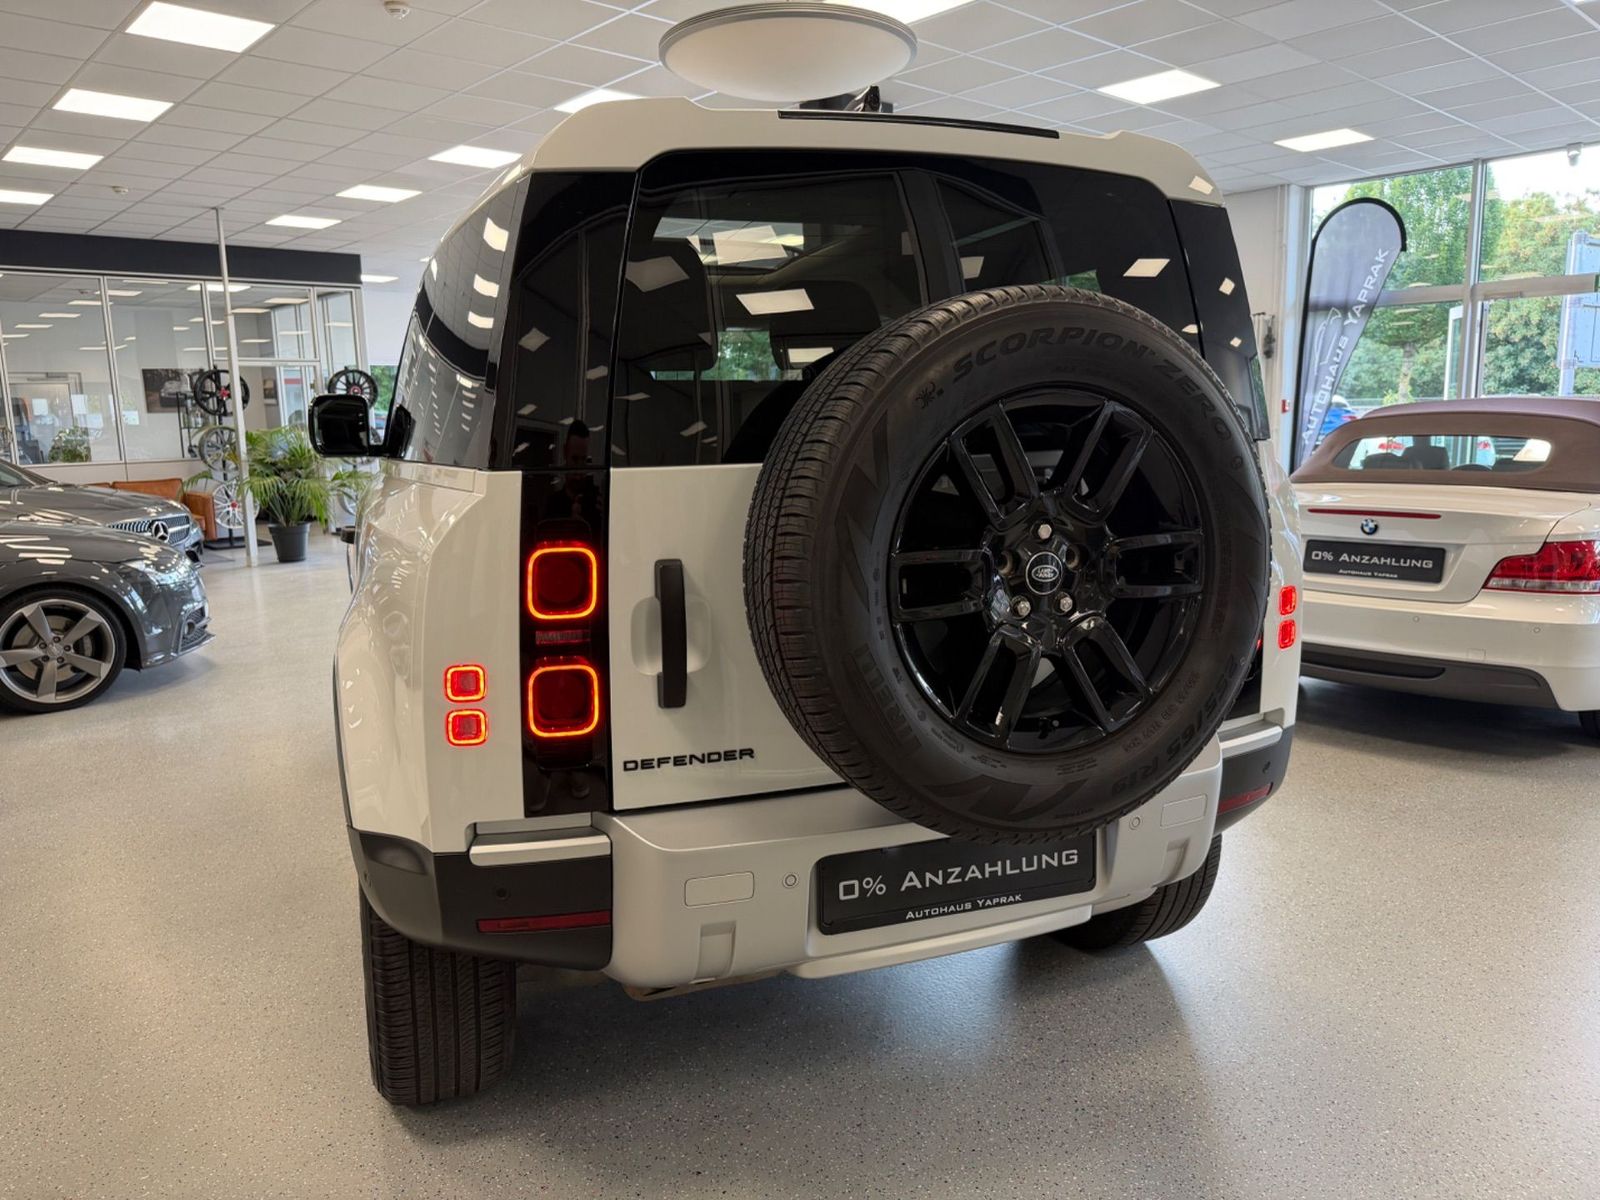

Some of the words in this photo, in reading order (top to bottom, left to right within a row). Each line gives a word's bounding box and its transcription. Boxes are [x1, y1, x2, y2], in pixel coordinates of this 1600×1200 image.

[1302, 336, 1350, 446] AUTOHAUS
[1344, 248, 1390, 327] YAPRAK
[953, 326, 1150, 384] SCORPION
[1154, 358, 1233, 441] ZERO
[1311, 550, 1334, 561] 0%
[1339, 553, 1433, 569] ANZAHLUNG
[623, 748, 755, 772] DEFENDER
[838, 875, 887, 901] 0%
[900, 849, 1079, 892] ANZAHLUNG
[905, 902, 973, 920] AUTOHAUS
[976, 893, 1023, 908] YAPRAK
